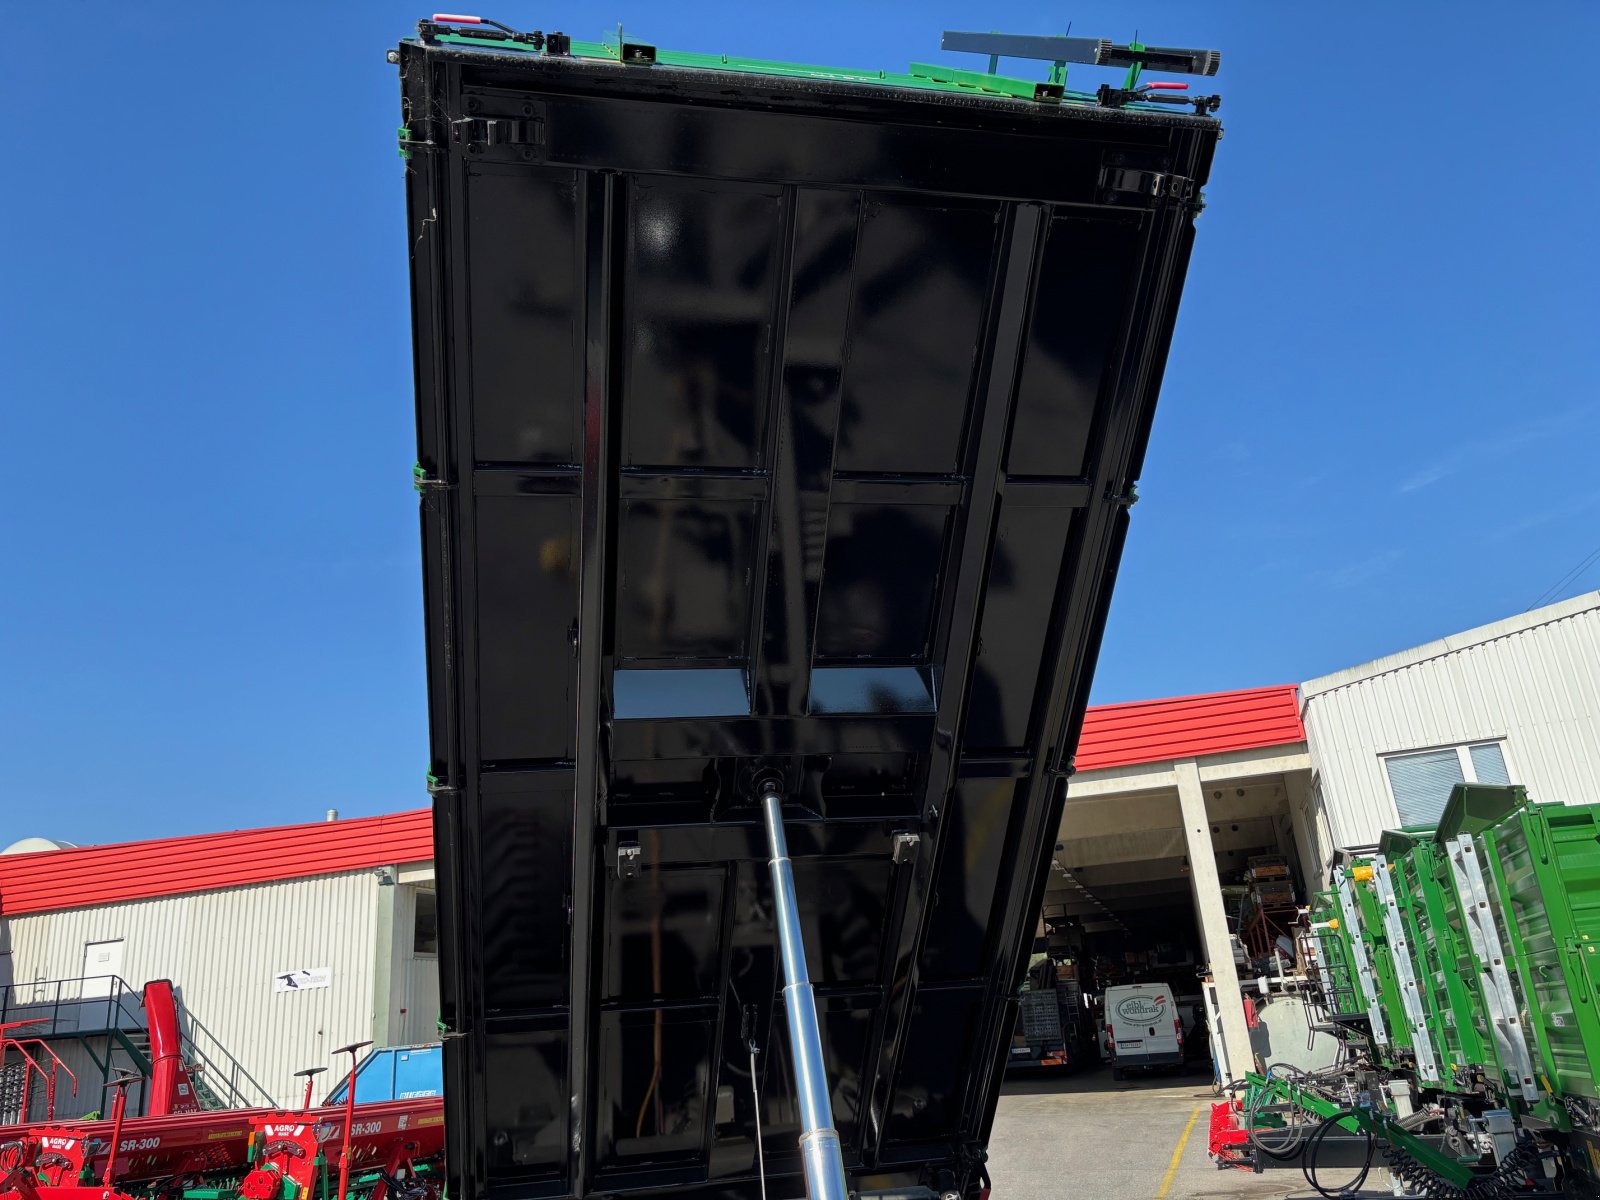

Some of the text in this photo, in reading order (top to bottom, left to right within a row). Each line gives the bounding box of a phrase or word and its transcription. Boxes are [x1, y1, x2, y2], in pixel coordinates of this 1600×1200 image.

[274, 1124, 295, 1132] AGRO
[350, 1121, 382, 1136] SR-300
[49, 1137, 67, 1145] AGRO
[119, 1137, 161, 1152] SR-300
